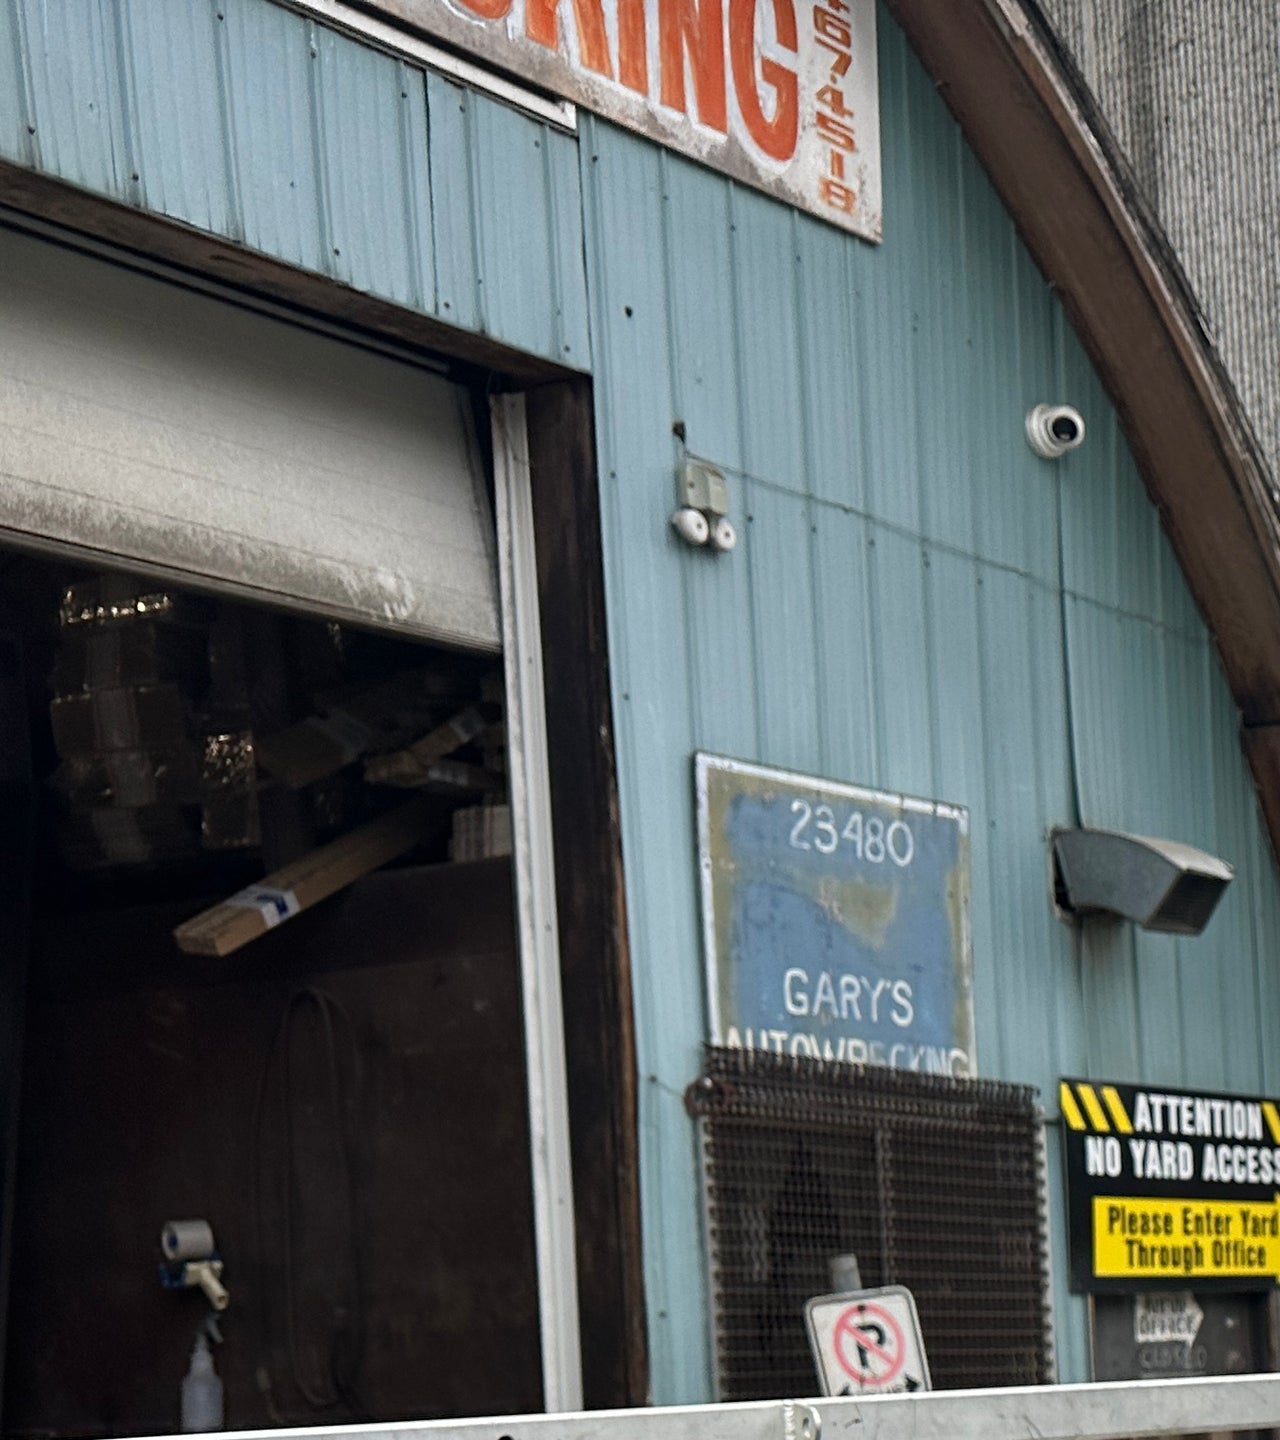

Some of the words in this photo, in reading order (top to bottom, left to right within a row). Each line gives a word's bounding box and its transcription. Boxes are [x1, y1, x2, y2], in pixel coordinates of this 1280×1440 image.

[789, 800, 914, 868] 23480
[783, 967, 915, 1028] GARY'S
[1134, 1092, 1264, 1141] ATTENTION
[1086, 1136, 1122, 1177] NO
[1128, 1140, 1195, 1181] YARD
[1108, 1206, 1174, 1236] Please
[1182, 1207, 1232, 1237] Enter
[1240, 1209, 1280, 1237] Yard
[1125, 1239, 1204, 1272] Through
[1212, 1240, 1267, 1267] Office
